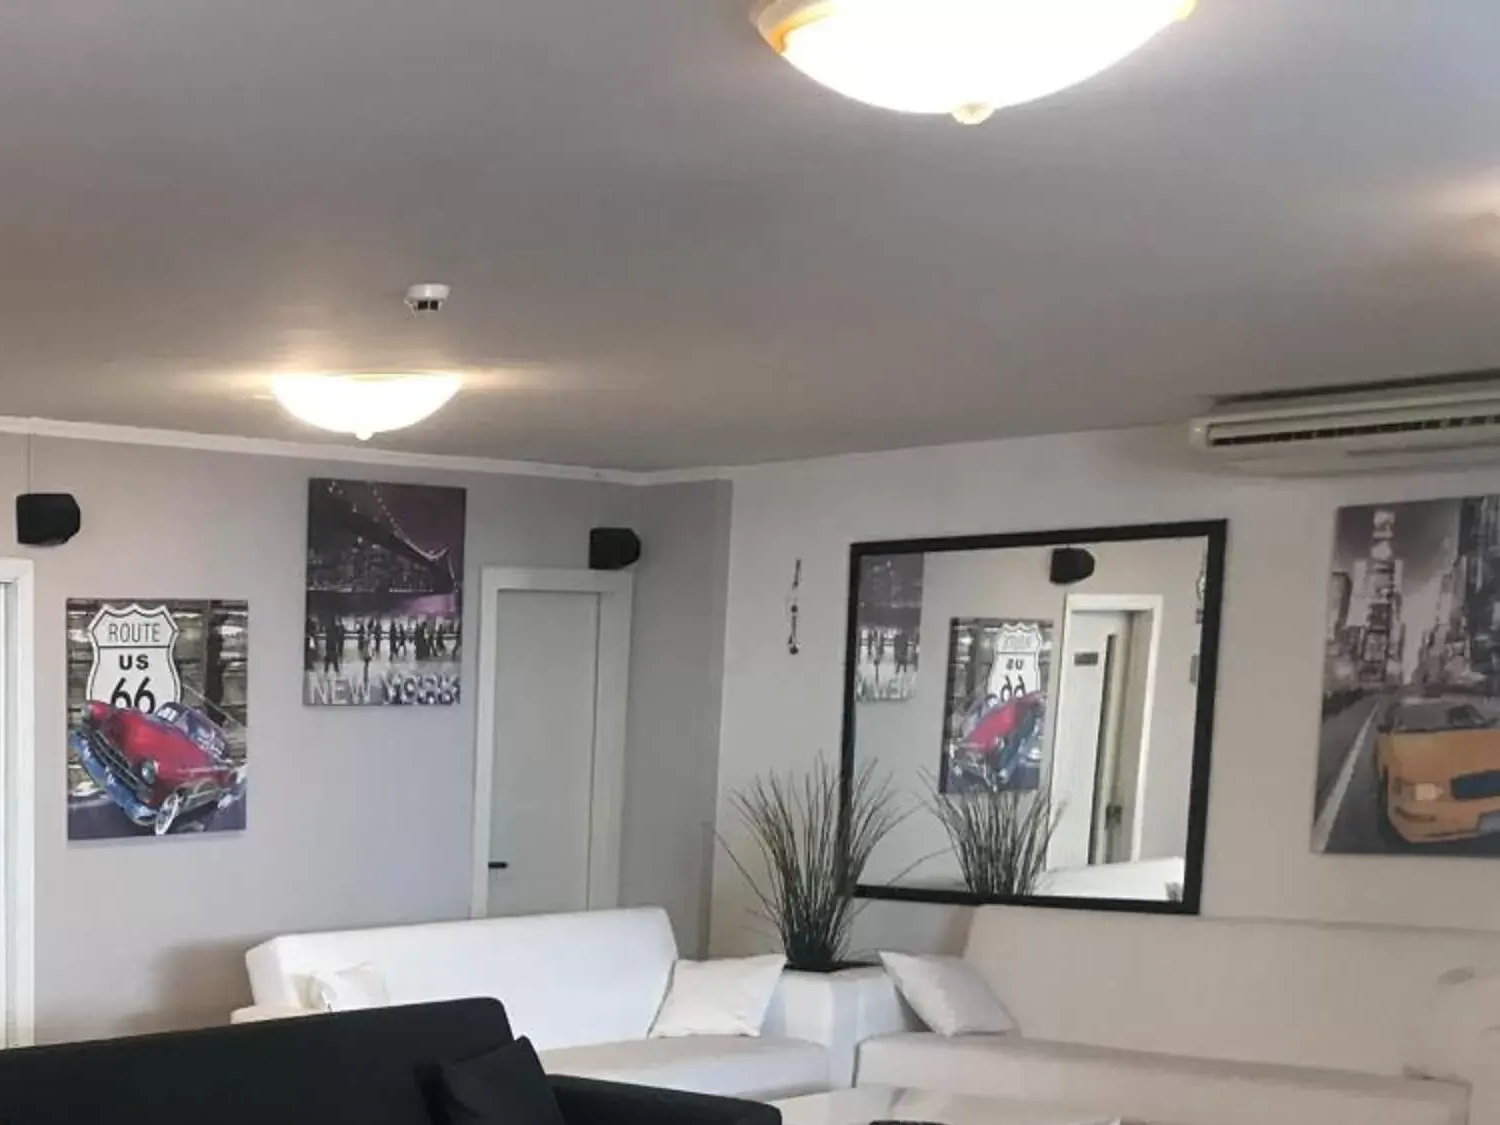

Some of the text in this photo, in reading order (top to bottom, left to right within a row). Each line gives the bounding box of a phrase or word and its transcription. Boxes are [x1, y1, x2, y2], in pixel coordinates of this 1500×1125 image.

[107, 622, 161, 643] ROUTE
[118, 653, 149, 671] US
[110, 676, 156, 714] 66
[308, 671, 461, 706] NEW YORK
